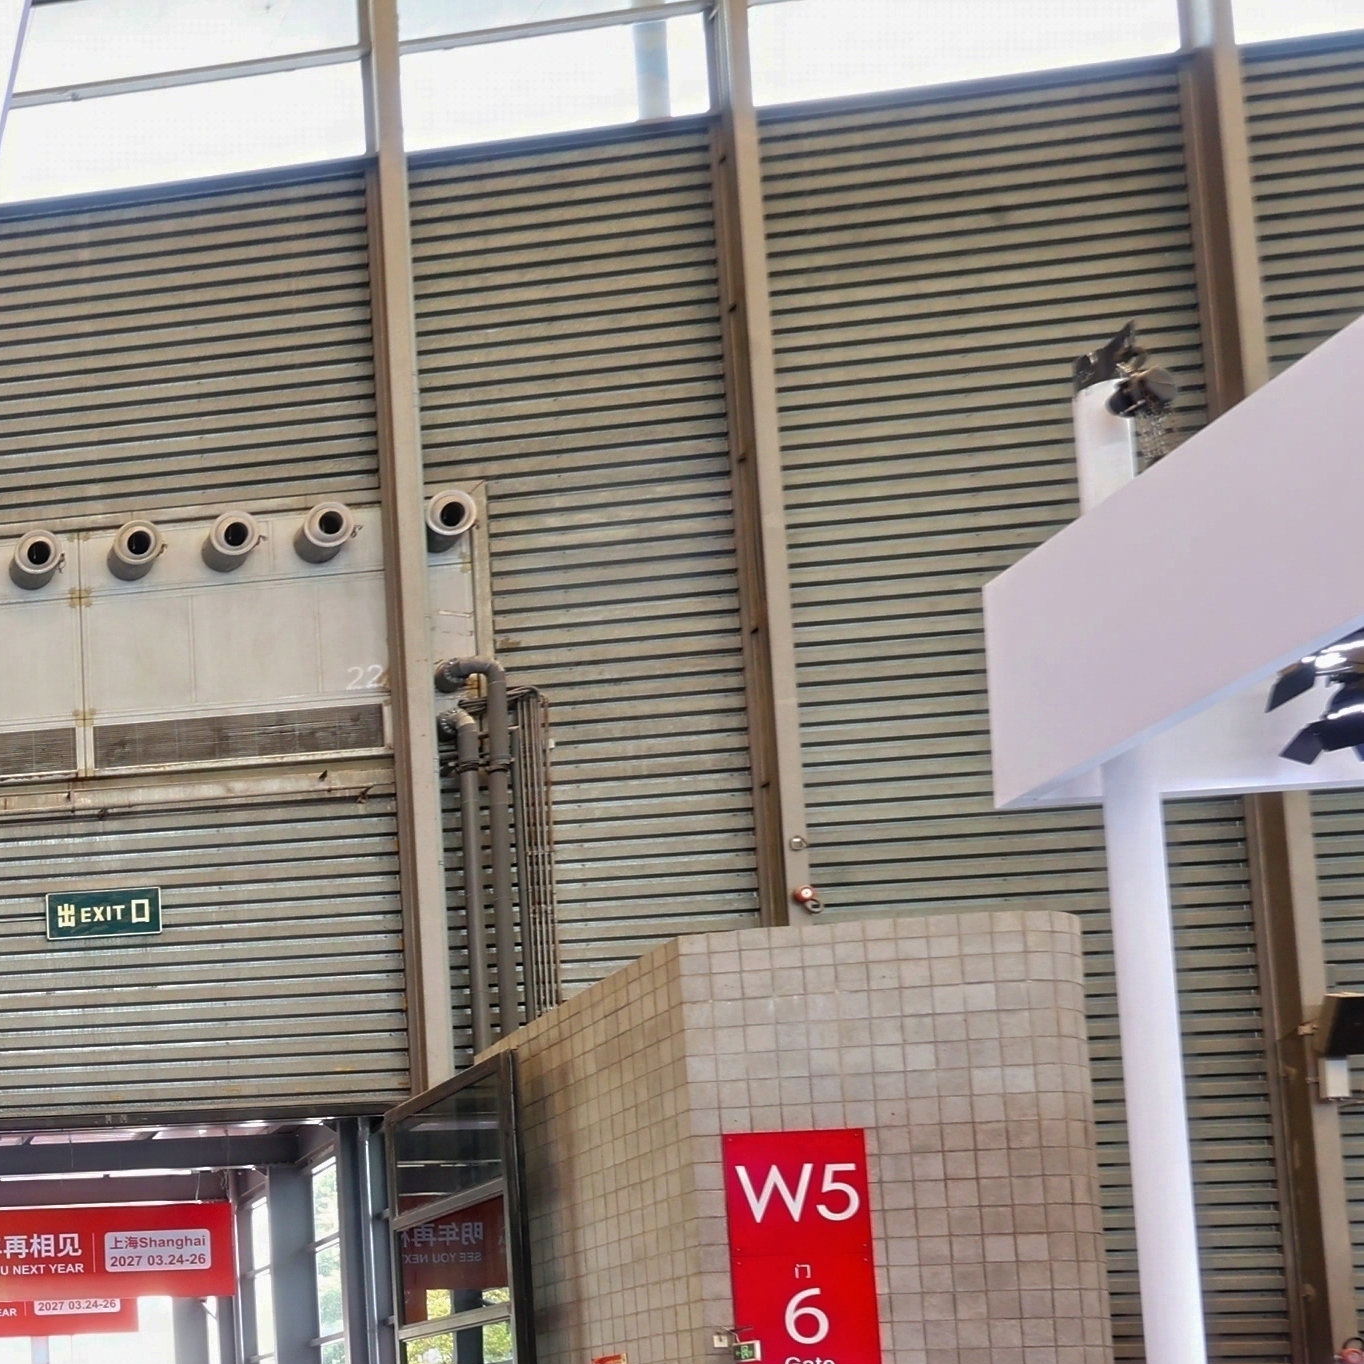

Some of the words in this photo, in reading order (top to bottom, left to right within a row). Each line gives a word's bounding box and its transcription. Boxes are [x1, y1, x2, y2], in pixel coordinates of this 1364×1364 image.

[346, 664, 386, 690] 22
[57, 903, 75, 928] 出
[80, 905, 126, 923] EXIT
[131, 899, 150, 923] 口
[735, 1163, 860, 1223] W5
[109, 1235, 206, 1251] 上海Shanghai
[12, 1264, 47, 1276] NEXT
[49, 1262, 85, 1275] YEAR
[110, 1255, 145, 1268] 2027
[147, 1253, 207, 1267] 03.24-26
[38, 1301, 63, 1312] 2027
[68, 1299, 117, 1311] 03.24-26
[784, 1287, 830, 1345] 6
